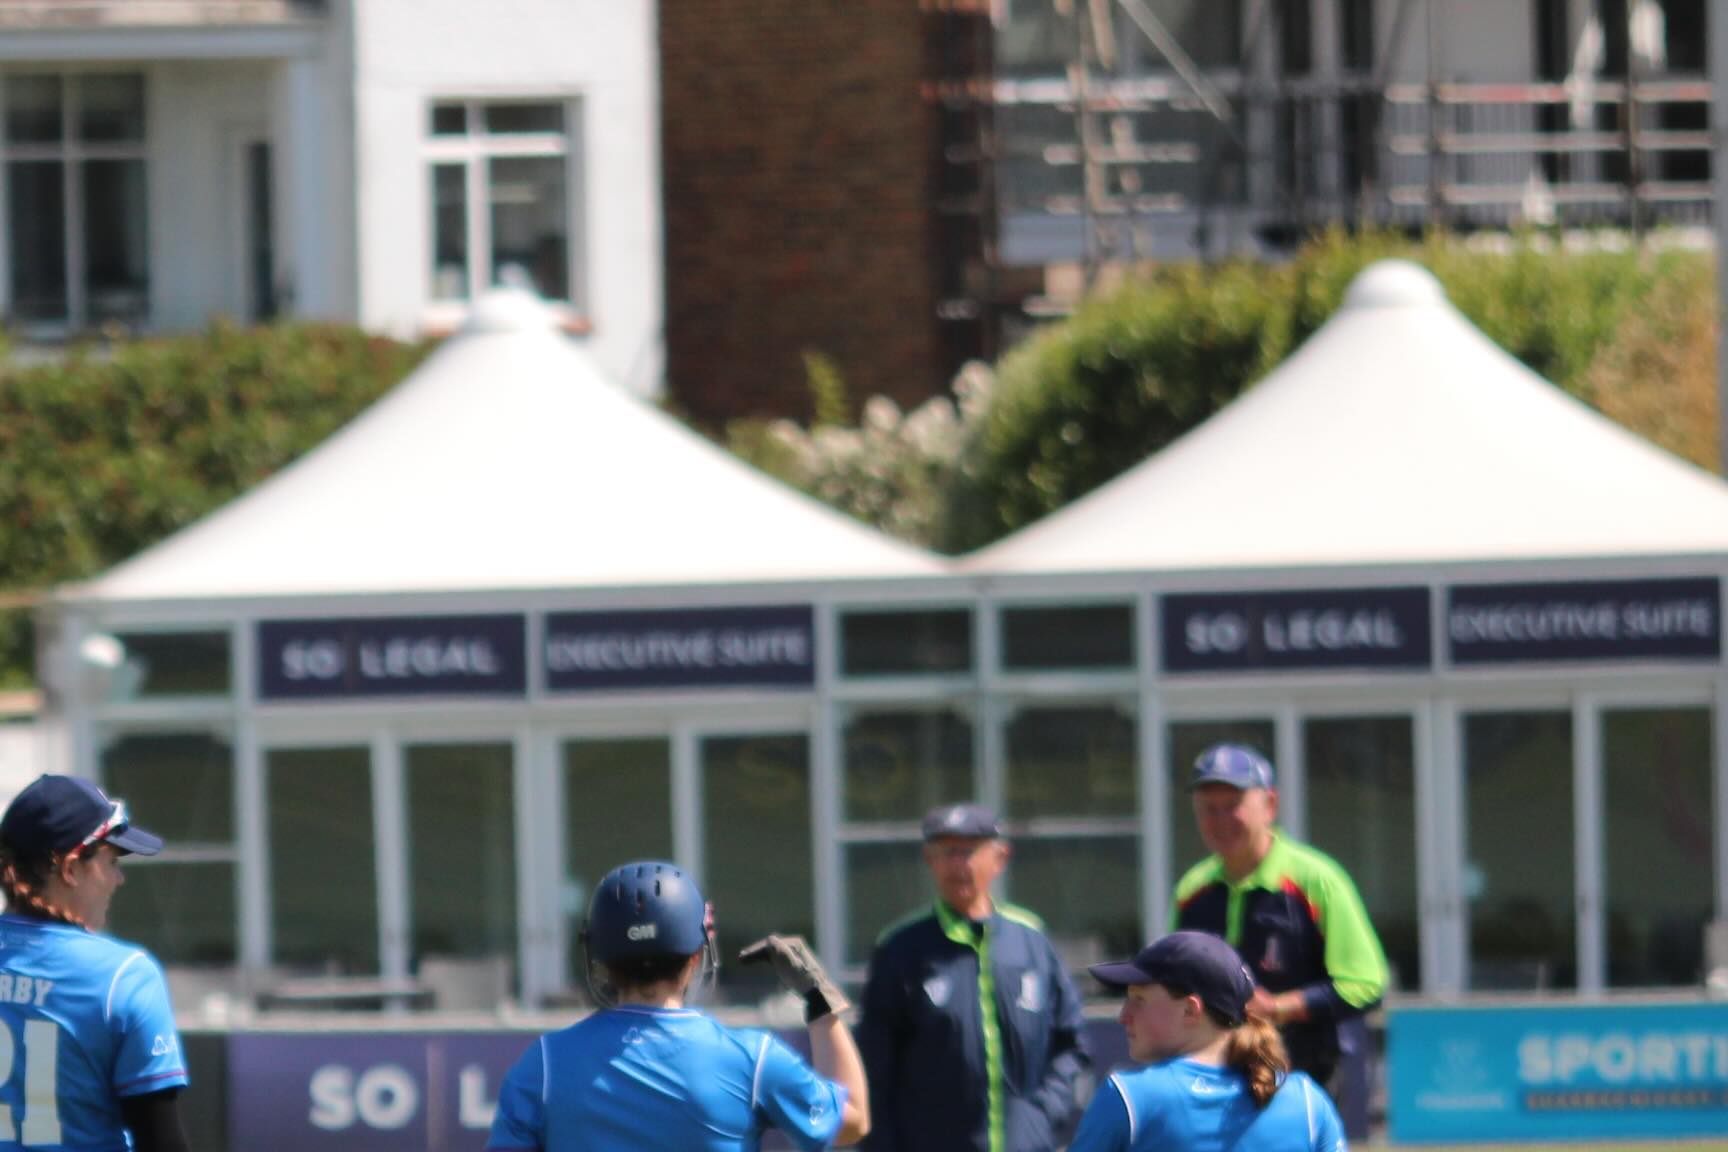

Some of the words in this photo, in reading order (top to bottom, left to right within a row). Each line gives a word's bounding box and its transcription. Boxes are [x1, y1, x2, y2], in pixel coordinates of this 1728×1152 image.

[1185, 612, 1245, 652] SO
[1263, 609, 1402, 650] LEGAL
[1450, 602, 1619, 643] EXECUTIVE
[1622, 600, 1712, 637] SUITE
[282, 638, 342, 680] SO
[359, 636, 498, 678] LEGAL
[547, 630, 713, 671] EXECUTIVE
[719, 628, 807, 664] SUITE
[308, 1064, 420, 1130] SO
